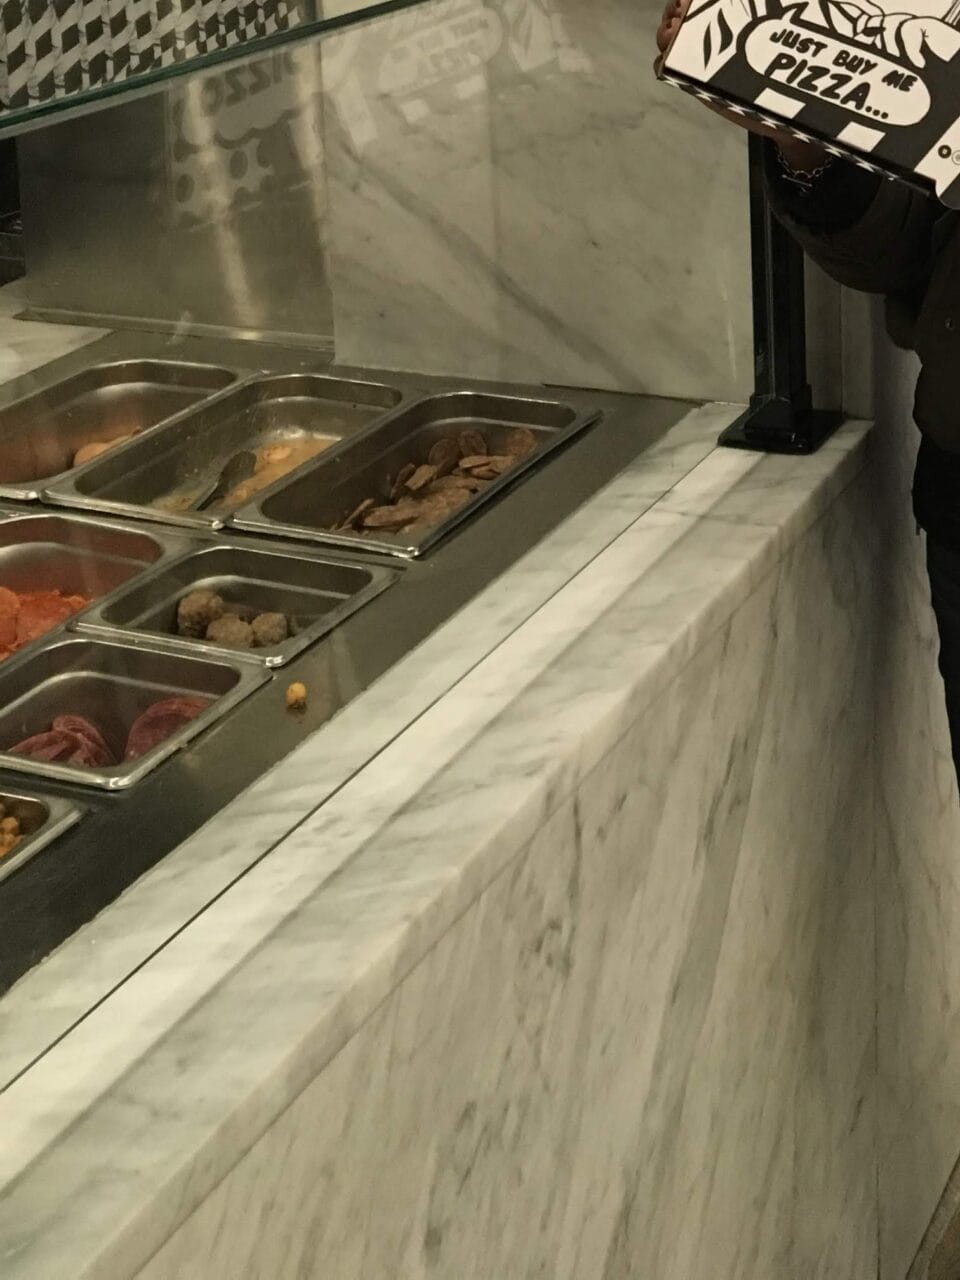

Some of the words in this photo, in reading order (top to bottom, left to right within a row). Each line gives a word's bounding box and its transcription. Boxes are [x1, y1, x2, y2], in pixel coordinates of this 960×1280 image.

[769, 28, 828, 58] JUST
[832, 49, 878, 76] BUY
[881, 70, 918, 92] ME
